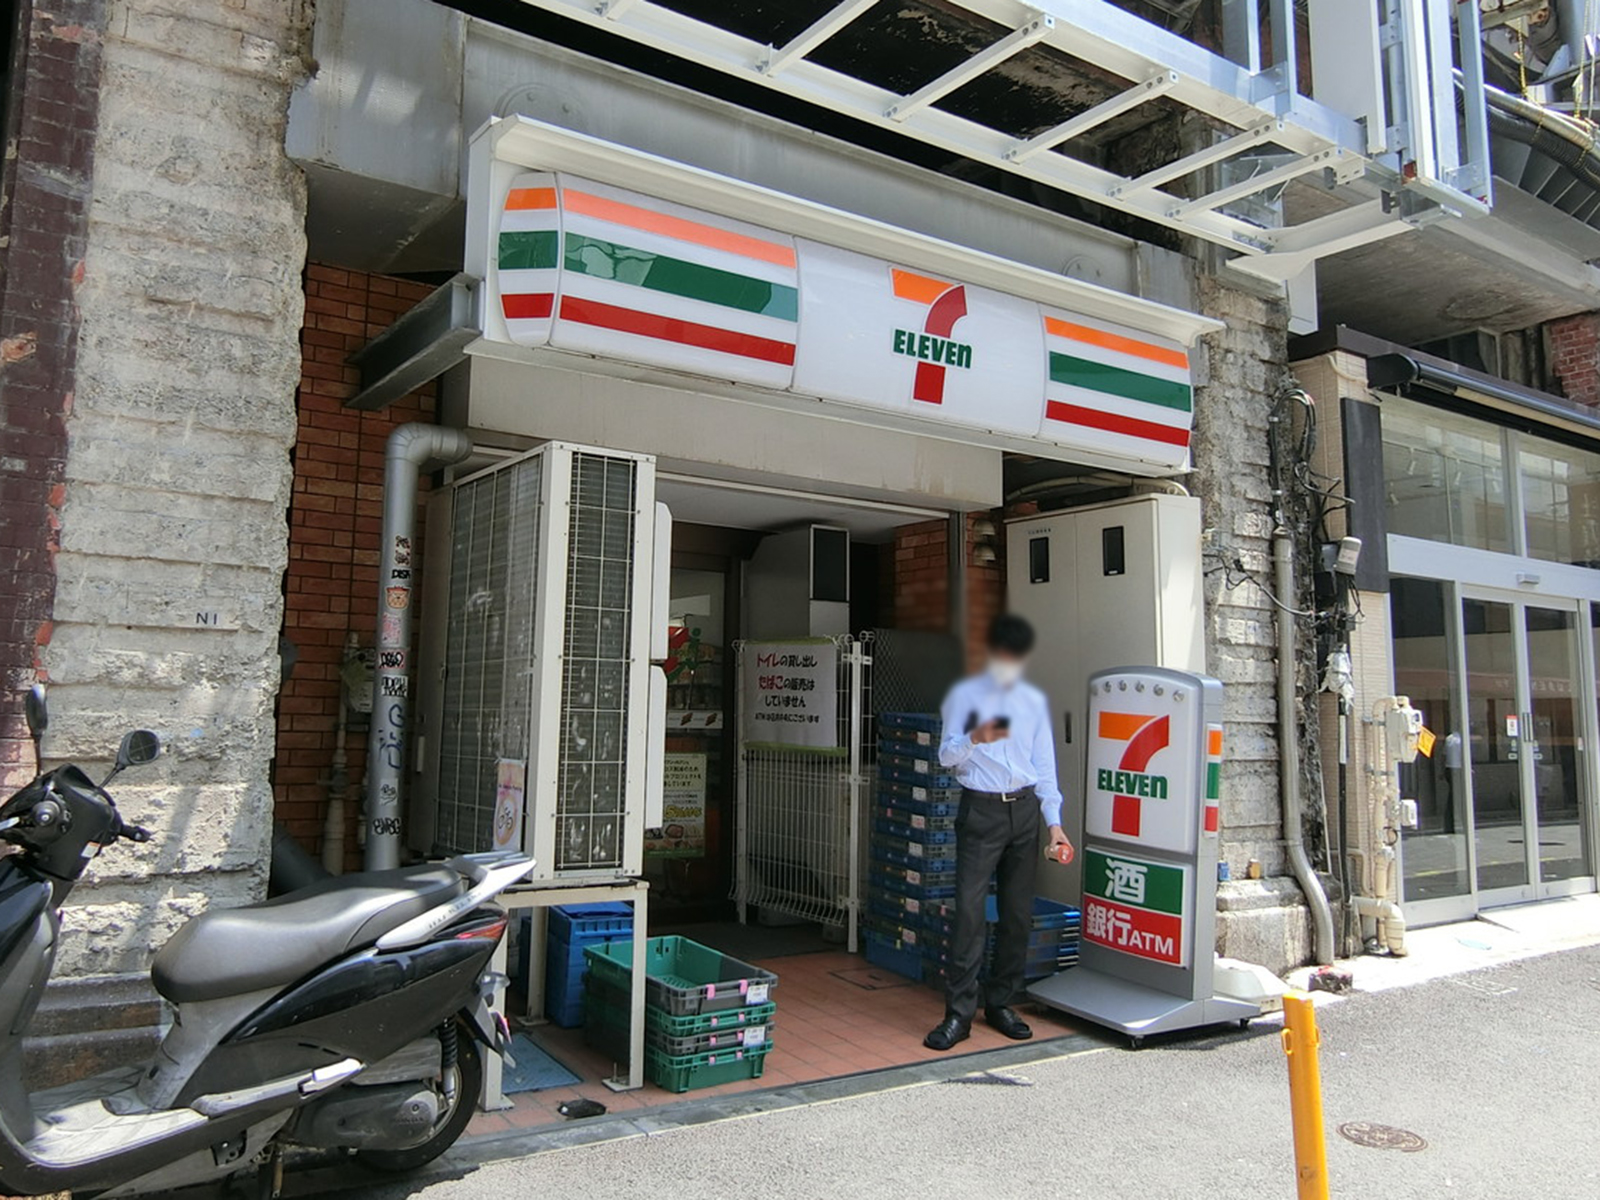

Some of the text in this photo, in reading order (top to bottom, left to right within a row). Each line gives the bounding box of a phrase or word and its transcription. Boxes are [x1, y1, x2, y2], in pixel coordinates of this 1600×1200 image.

[891, 268, 967, 405] 7
[757, 653, 818, 667] トイレの貸し出し
[758, 675, 815, 691] たばこの販売は
[765, 695, 806, 708] していません
[1098, 711, 1170, 837] 7
[1104, 857, 1148, 904] 酒
